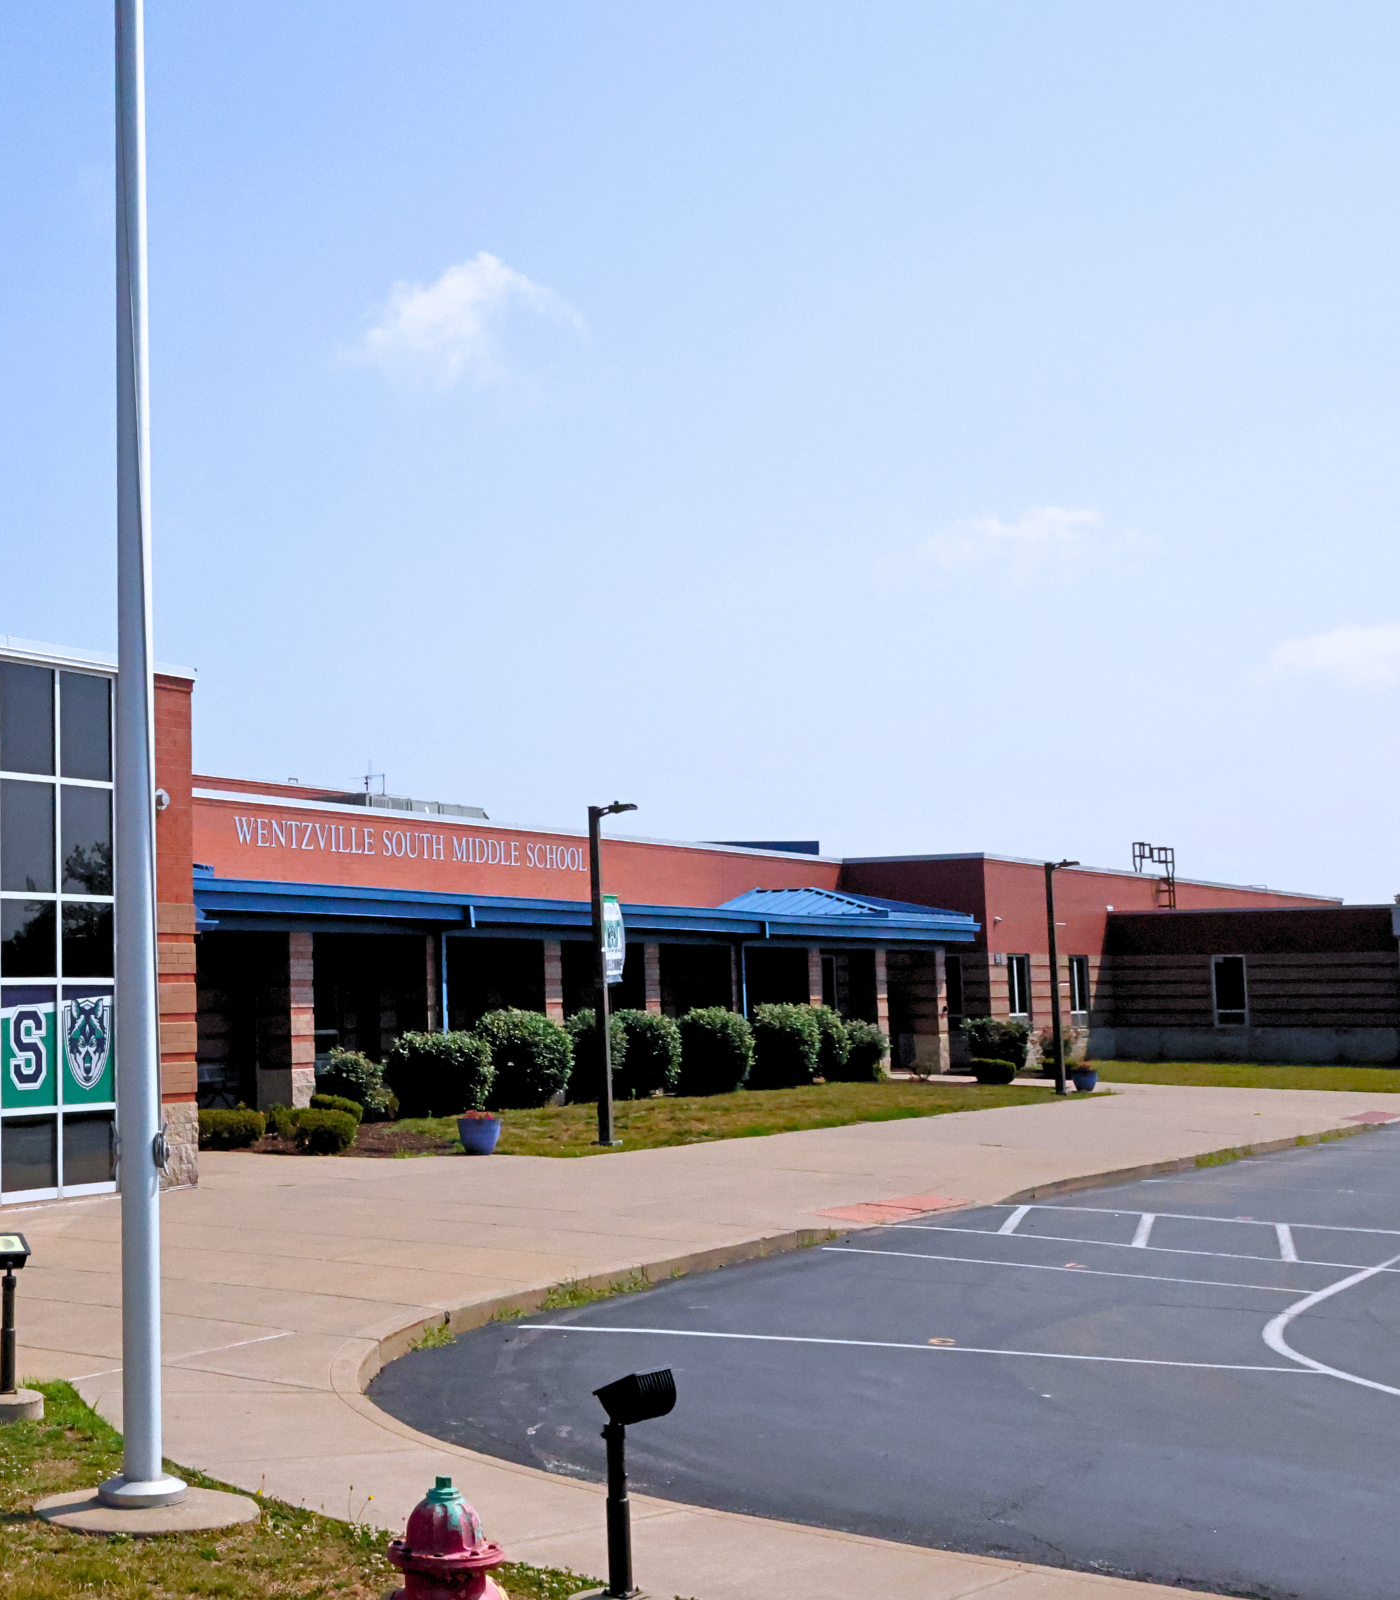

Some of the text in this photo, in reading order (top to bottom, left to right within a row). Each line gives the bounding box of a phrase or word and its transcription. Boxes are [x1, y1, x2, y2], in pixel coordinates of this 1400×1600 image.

[233, 815, 588, 872] WENTZVILLE SOUTH MIDDLE SCHOOL
